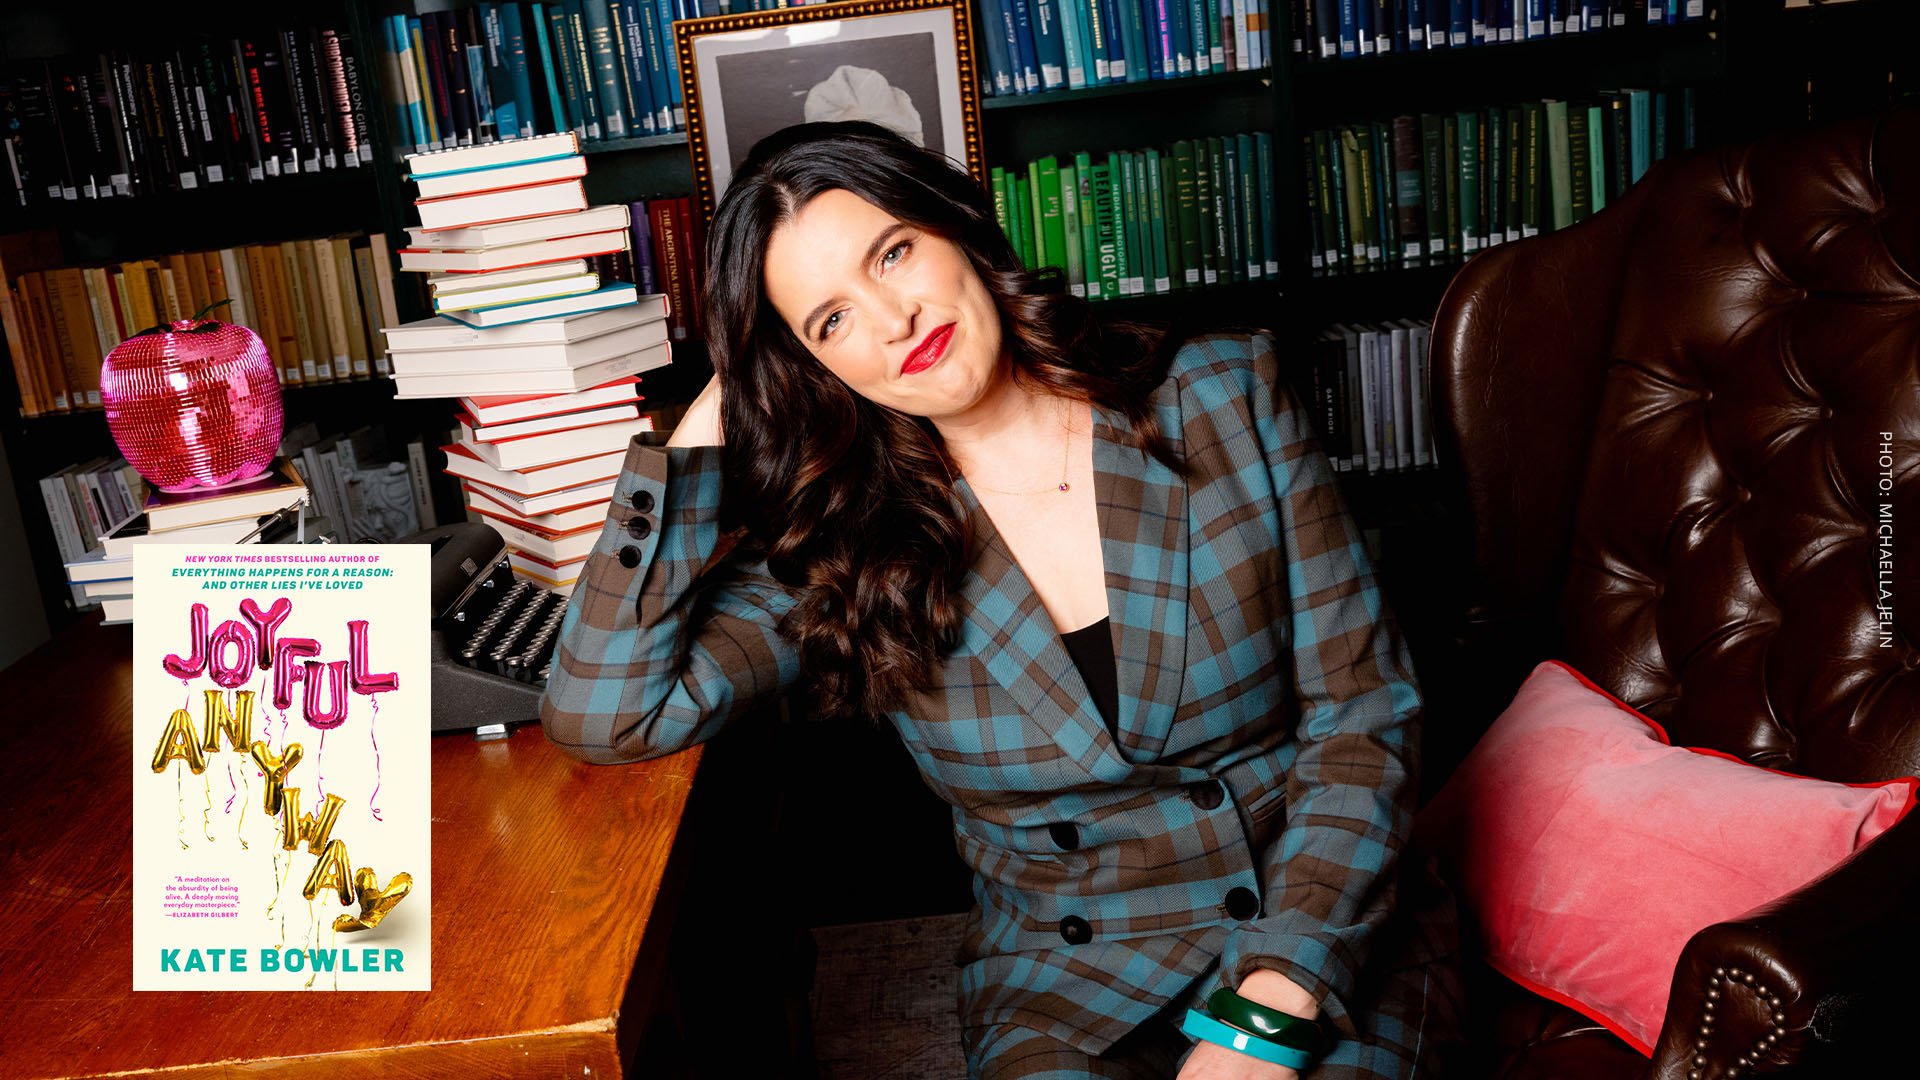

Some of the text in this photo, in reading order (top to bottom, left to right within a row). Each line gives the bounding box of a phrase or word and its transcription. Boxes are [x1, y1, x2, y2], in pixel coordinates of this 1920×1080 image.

[1193, 4, 1205, 50] MOVEMENT
[291, 47, 300, 74] SOCIAL
[322, 35, 351, 112] SUBCOMMANDER
[122, 64, 138, 116] Pharmocracy
[295, 77, 307, 112] MEDICINE
[345, 56, 370, 145] BABYLON GIRLS
[302, 115, 312, 144] READER
[1429, 146, 1437, 186] TROPICAL
[662, 208, 671, 227] THE
[1112, 183, 1127, 276] MEDIA HETEROTOPIAS
[664, 228, 679, 280] ARGENTINA
[1101, 243, 1117, 279] UGLY
[671, 283, 683, 318] READER
[1327, 407, 1335, 434] PRIORI
